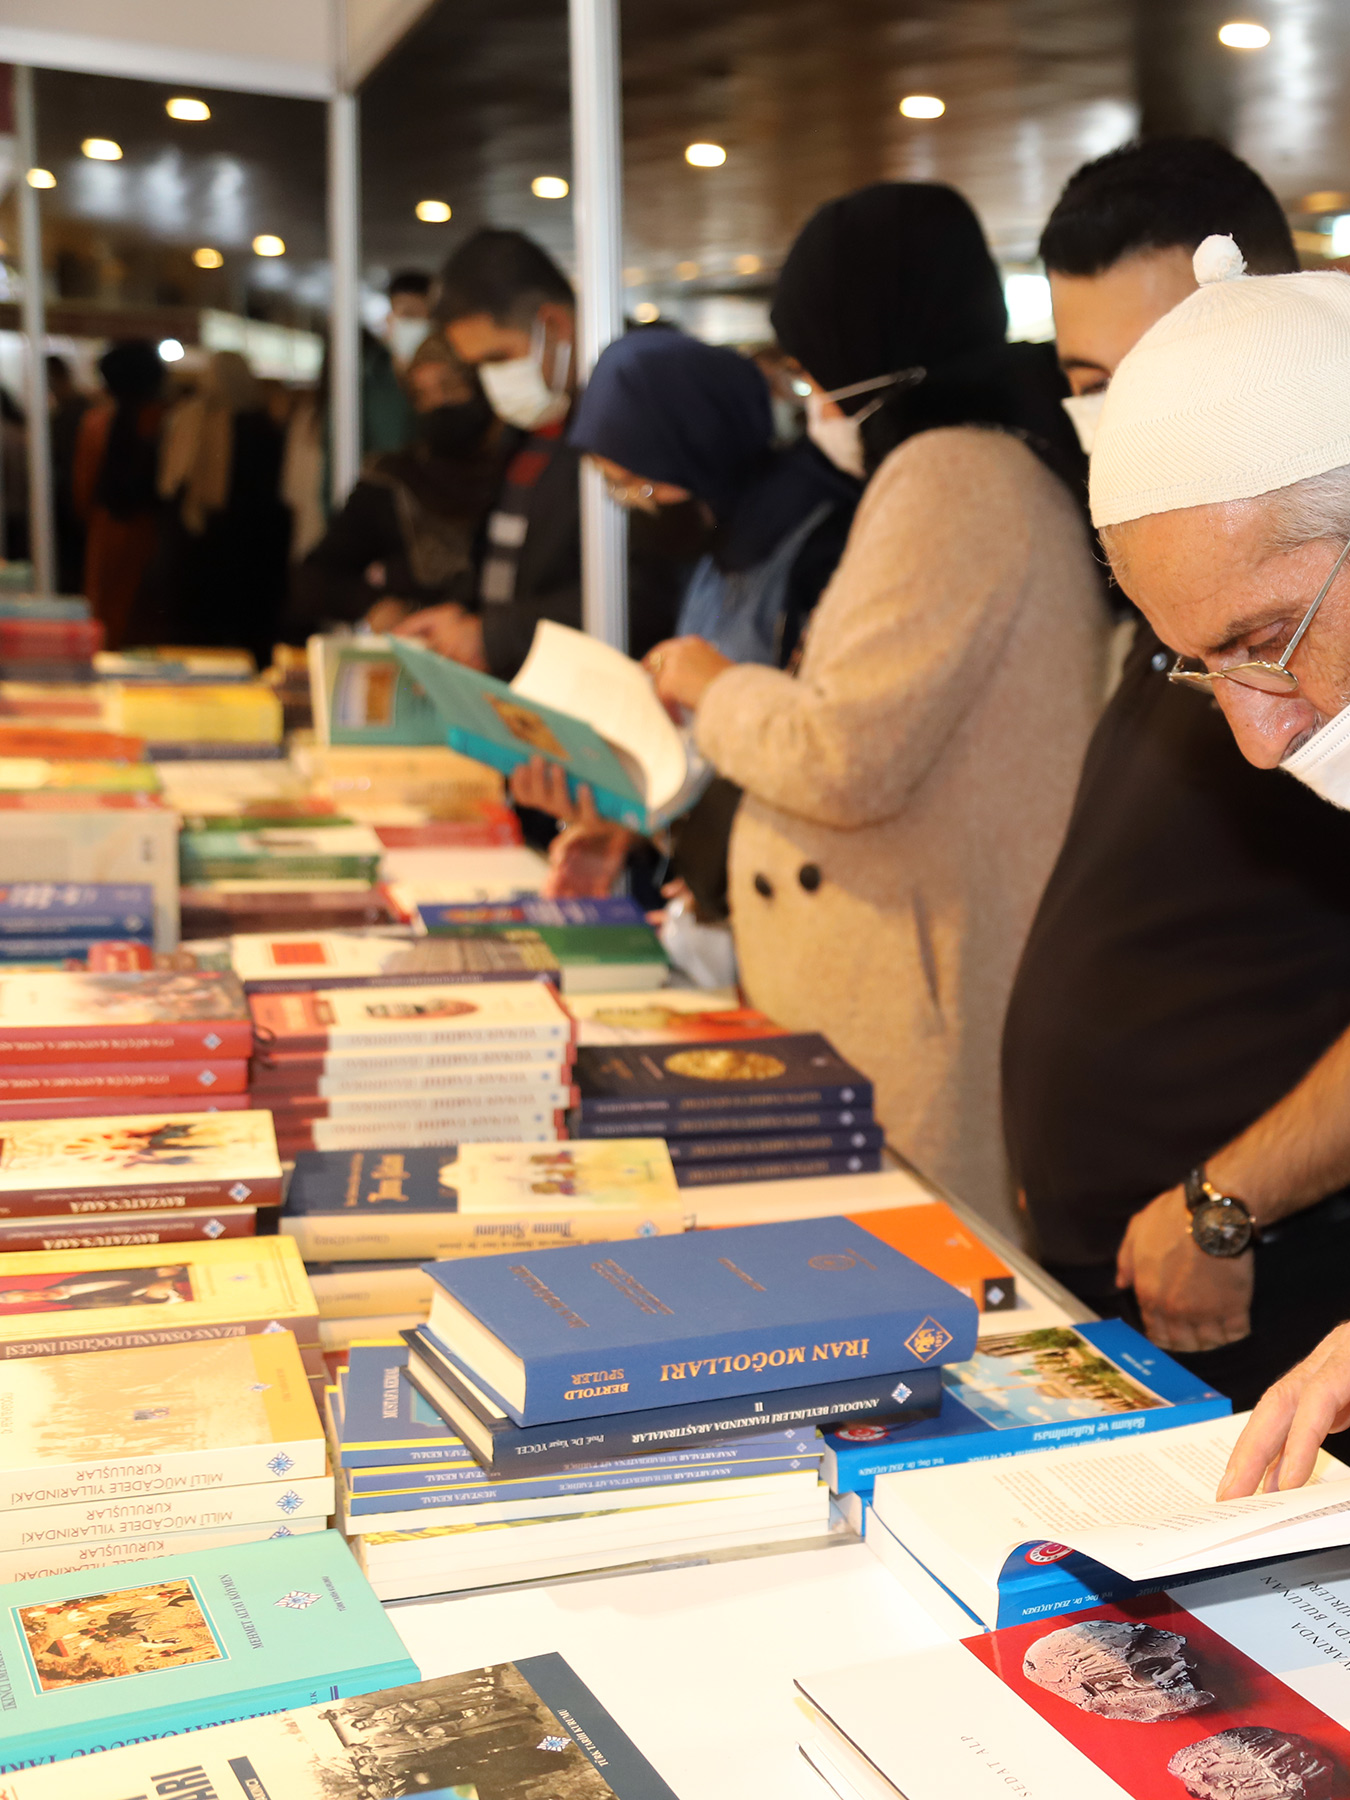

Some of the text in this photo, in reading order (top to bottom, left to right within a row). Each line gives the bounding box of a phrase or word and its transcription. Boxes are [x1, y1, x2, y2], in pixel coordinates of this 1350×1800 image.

[5, 1342, 56, 1358] İMGESİ
[59, 1336, 123, 1351] DOĞUSU
[660, 1338, 870, 1382] İRAN MOĞOLLARI
[571, 1367, 625, 1386] SPULER
[564, 1382, 629, 1400] BERTOLD
[754, 1401, 764, 1412] II
[515, 1397, 879, 1456] ANADOLU BEYLİKLERİ HAKKINDA ARAŞTIRMALAR Prof. Dr. Yaşar YÜCEL
[1032, 1417, 1146, 1441] Bakımı ve Kullanılması
[411, 1451, 442, 1459] KEMAL
[679, 1450, 737, 1462] ANAFARTALAR
[76, 1462, 162, 1482] KURULUŞLAR
[425, 1473, 457, 1481] KEMAL
[674, 1468, 732, 1479] ANAFARTALAR
[109, 1476, 187, 1494] MÜCÂDELE
[10, 1485, 106, 1505] YILLARINDAKİ
[420, 1493, 453, 1505] KEMAL
[455, 1490, 497, 1503] MUSTAFA
[86, 1501, 172, 1521] KURULUŞLAR
[21, 1523, 115, 1544] YILLARINDAKİ
[119, 1514, 197, 1534] MÜCÂDELE
[79, 1540, 164, 1560] KURULUŞLAR
[1053, 1600, 1071, 1612] ZEKİ
[1259, 1575, 1328, 1622] BULUNAN
[219, 1573, 264, 1651] MEHMET ALTAY KÖYMEN
[1022, 1602, 1053, 1615] ATÇEKEN
[558, 1708, 608, 1766] TÜRK TARİH KURUMU
[960, 1734, 1033, 1798] SEDAT ALP
